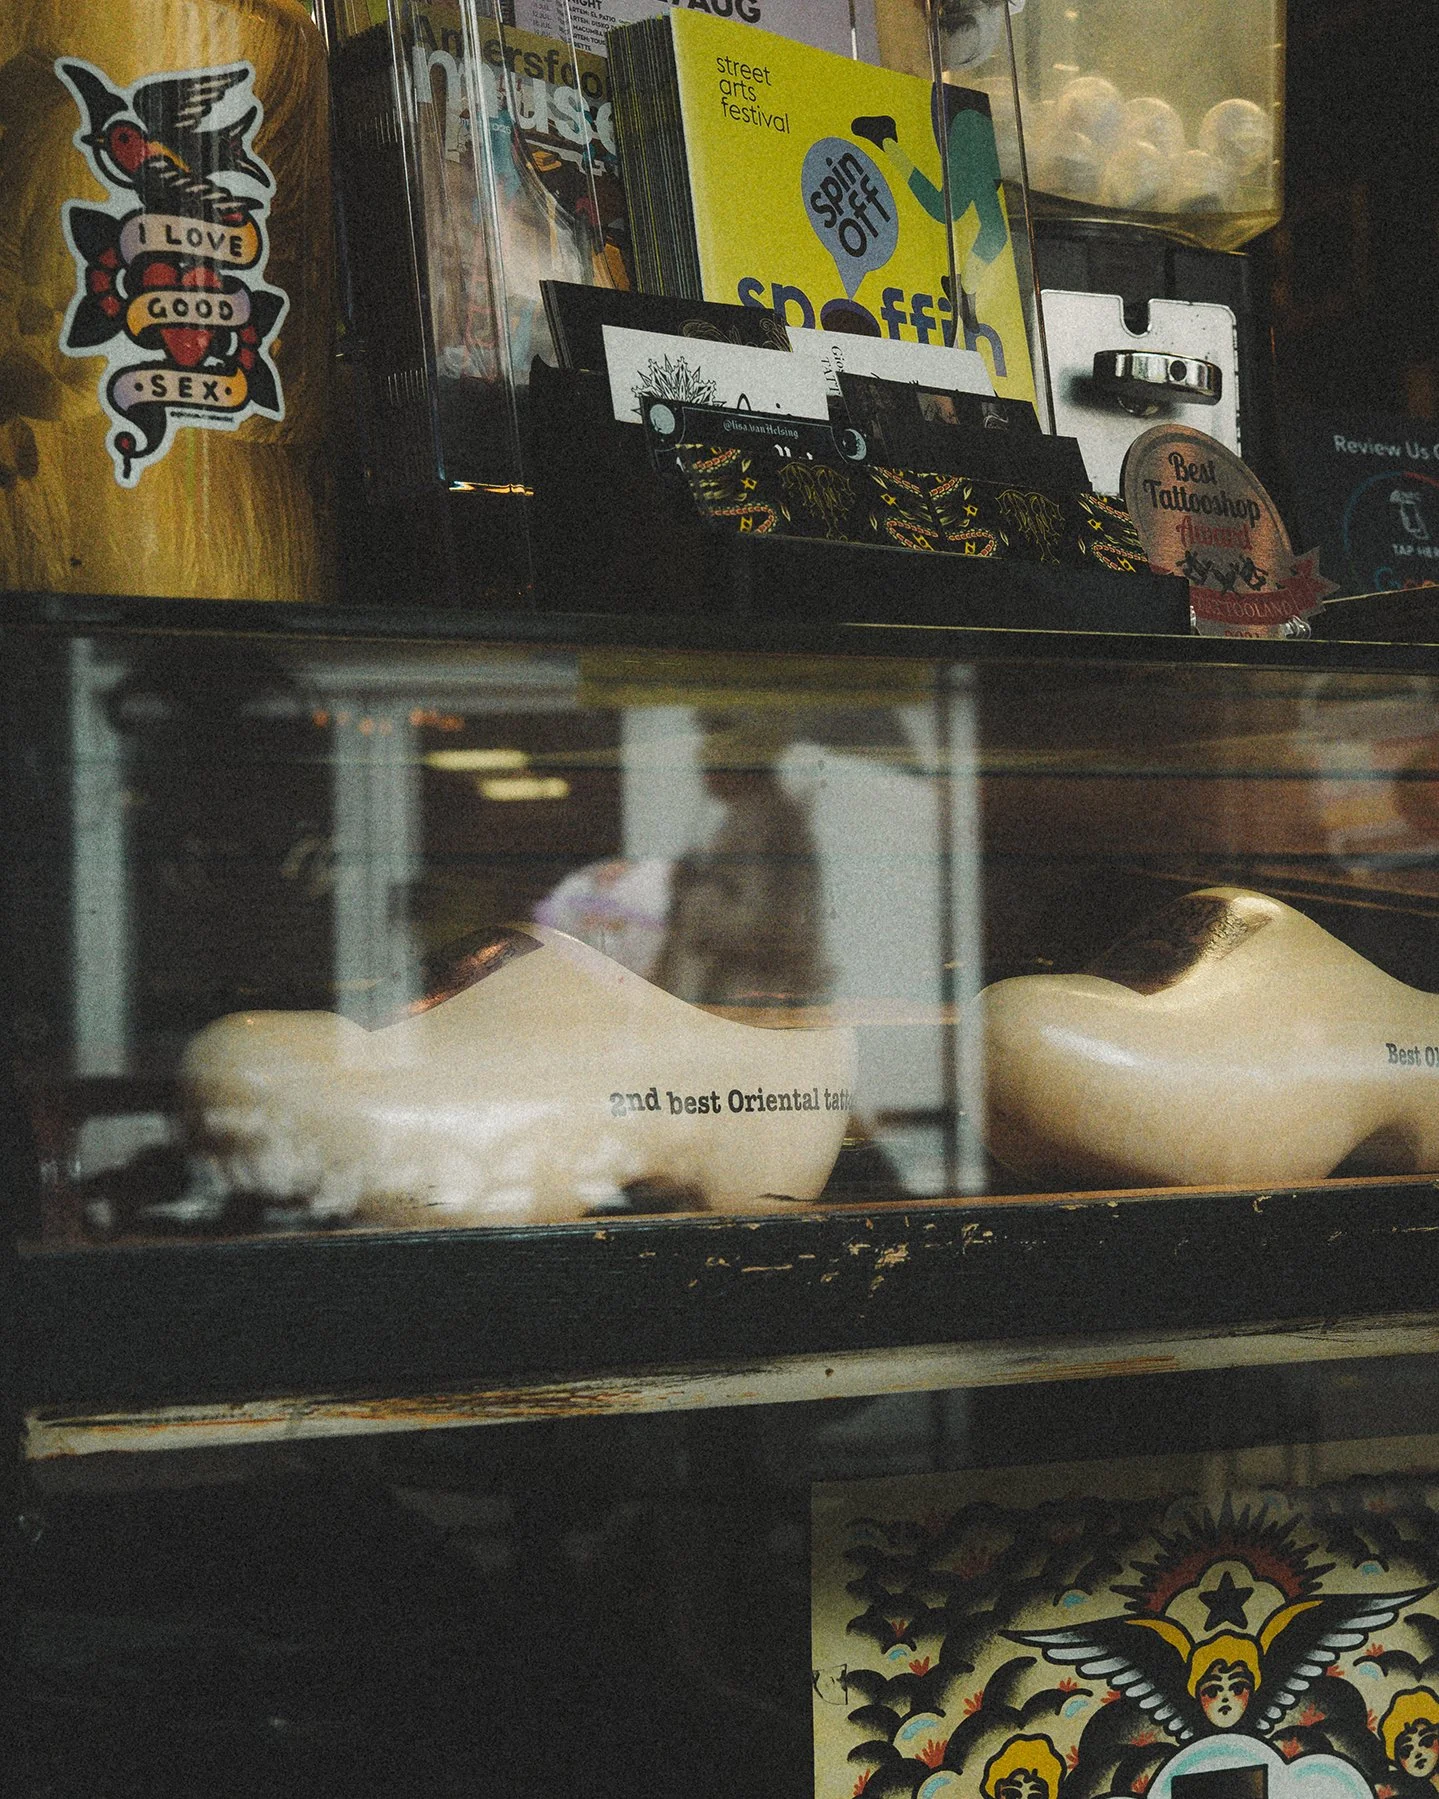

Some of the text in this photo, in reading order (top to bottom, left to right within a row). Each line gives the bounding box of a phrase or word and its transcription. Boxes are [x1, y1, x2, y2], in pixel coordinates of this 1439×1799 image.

[402, 14, 614, 103] Amersfoo
[716, 55, 772, 86] street
[719, 78, 757, 102] arts
[721, 97, 790, 134] festival
[810, 152, 864, 229] spin
[838, 174, 891, 258] off
[138, 223, 243, 258] I LOVE
[147, 297, 234, 321] GOOD
[1333, 434, 1401, 458] Review
[1405, 441, 1430, 460] Us
[1168, 451, 1218, 485] Best
[1142, 479, 1261, 528] Tattooshop
[1385, 1042, 1421, 1067] Best
[609, 1087, 853, 1117] 2nd best Oriental tatt
